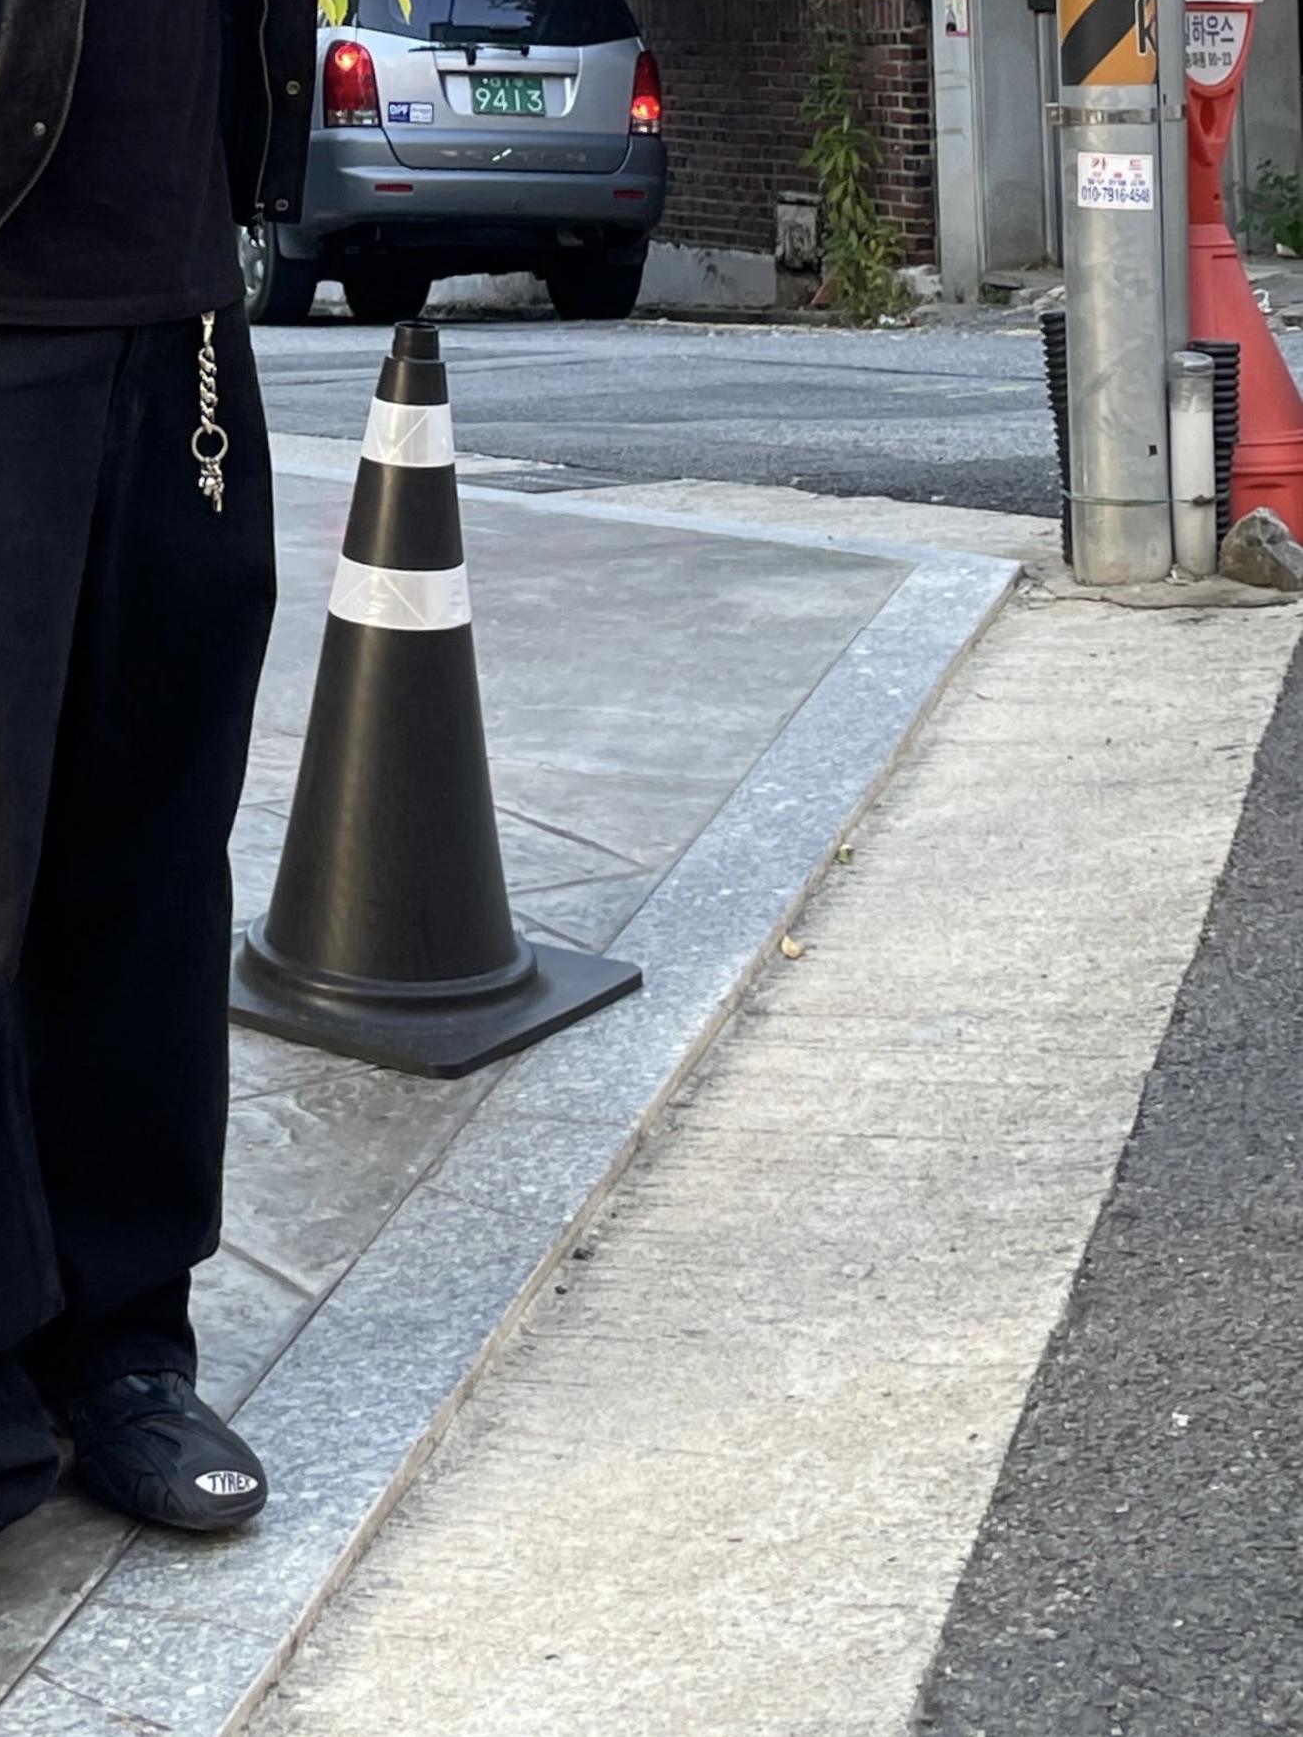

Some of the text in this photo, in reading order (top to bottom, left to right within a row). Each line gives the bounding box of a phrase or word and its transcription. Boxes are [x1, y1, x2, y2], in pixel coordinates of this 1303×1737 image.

[1186, 14, 1234, 46] 하우스
[475, 88, 542, 112] 9413
[207, 1472, 252, 1493] TYREX
